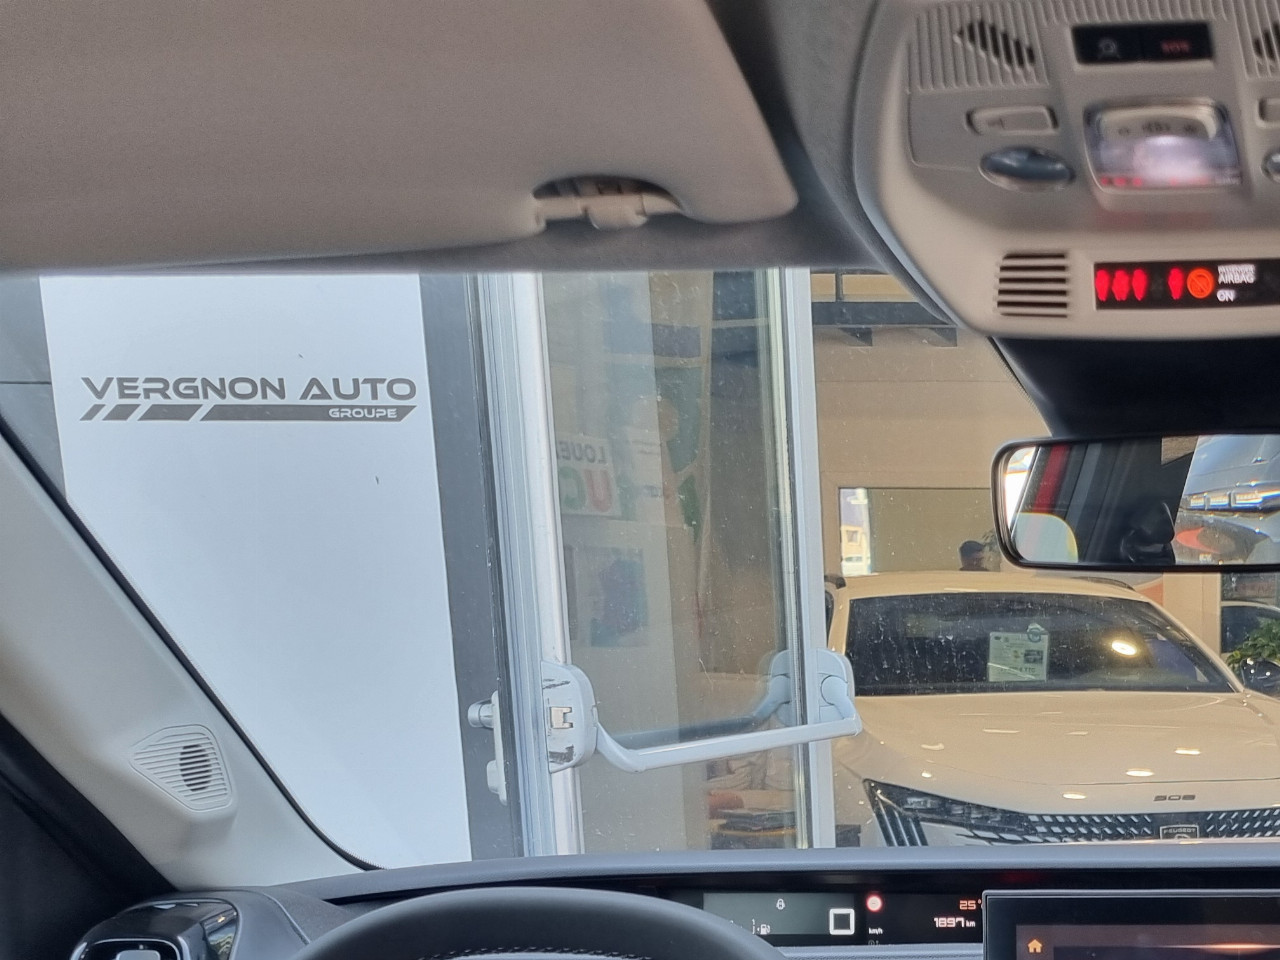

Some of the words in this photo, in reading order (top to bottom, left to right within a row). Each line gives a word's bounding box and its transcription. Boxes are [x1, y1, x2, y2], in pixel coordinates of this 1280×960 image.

[1218, 272, 1256, 284] AIRBAG
[1217, 289, 1236, 302] ON
[81, 377, 286, 401] VERGNON
[299, 377, 417, 401] AUTO
[329, 408, 398, 418] GROUPE
[960, 899, 982, 910] 25°
[934, 917, 965, 928] 1897
